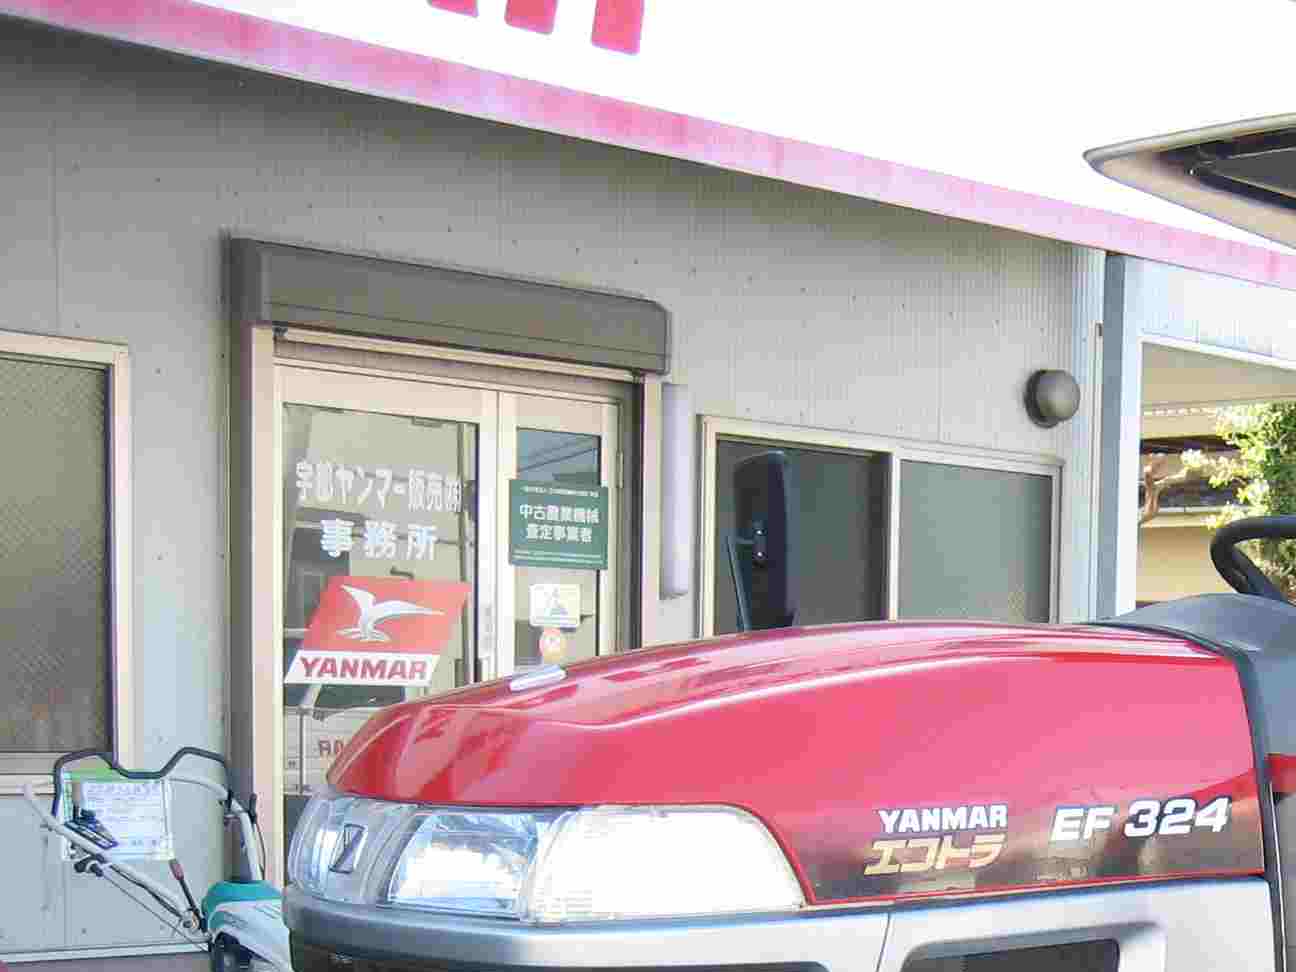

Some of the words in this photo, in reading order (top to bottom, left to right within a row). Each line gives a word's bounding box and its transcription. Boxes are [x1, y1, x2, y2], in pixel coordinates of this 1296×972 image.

[300, 656, 428, 680] YANMAR
[878, 805, 1008, 833] YANMAR
[1051, 806, 1117, 842] EF
[1121, 796, 1232, 839] 324
[863, 833, 1006, 876] エコトラ
